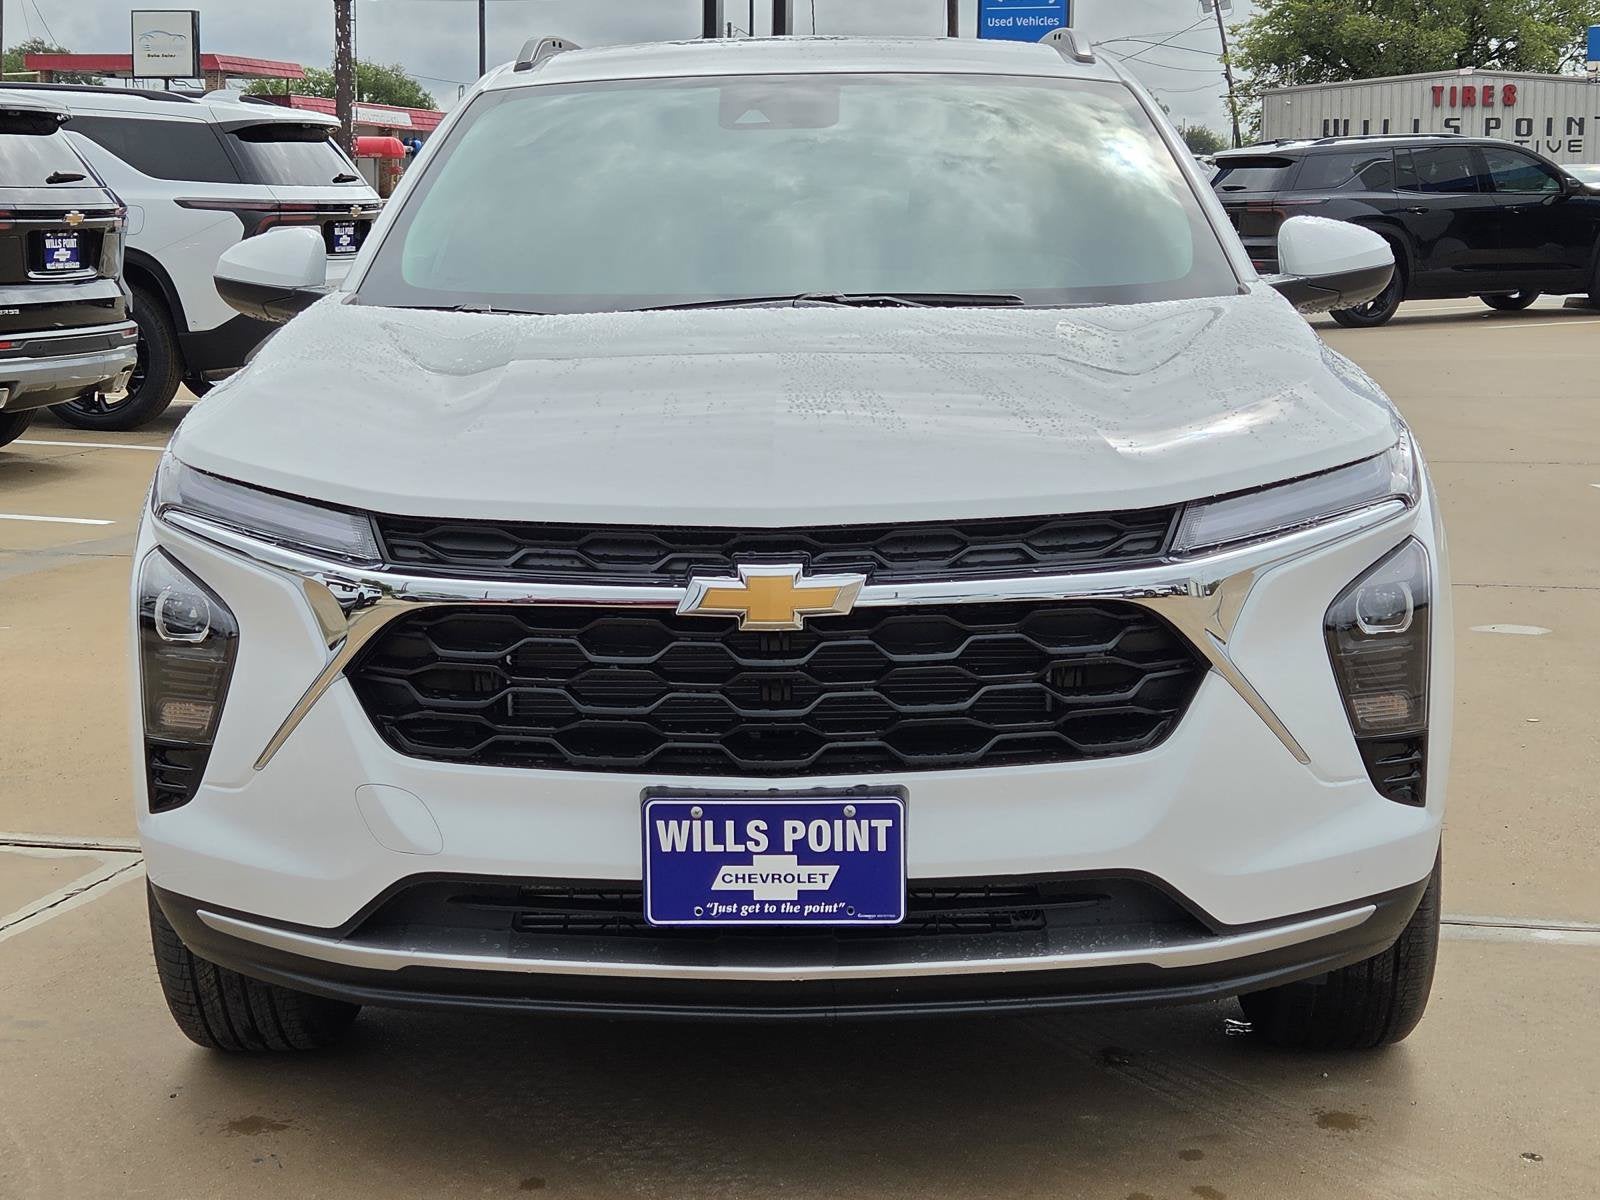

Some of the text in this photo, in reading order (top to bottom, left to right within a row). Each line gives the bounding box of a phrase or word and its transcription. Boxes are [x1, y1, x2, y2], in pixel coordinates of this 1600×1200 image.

[987, 16, 1060, 27] Used Vehicles
[1431, 83, 1518, 108] TIRES
[45, 239, 62, 249] WILLS
[656, 819, 893, 853] WILLS POINT
[721, 873, 830, 884] CHEVROLET
[740, 904, 761, 916] get
[764, 903, 777, 914] to
[780, 902, 801, 914] the
